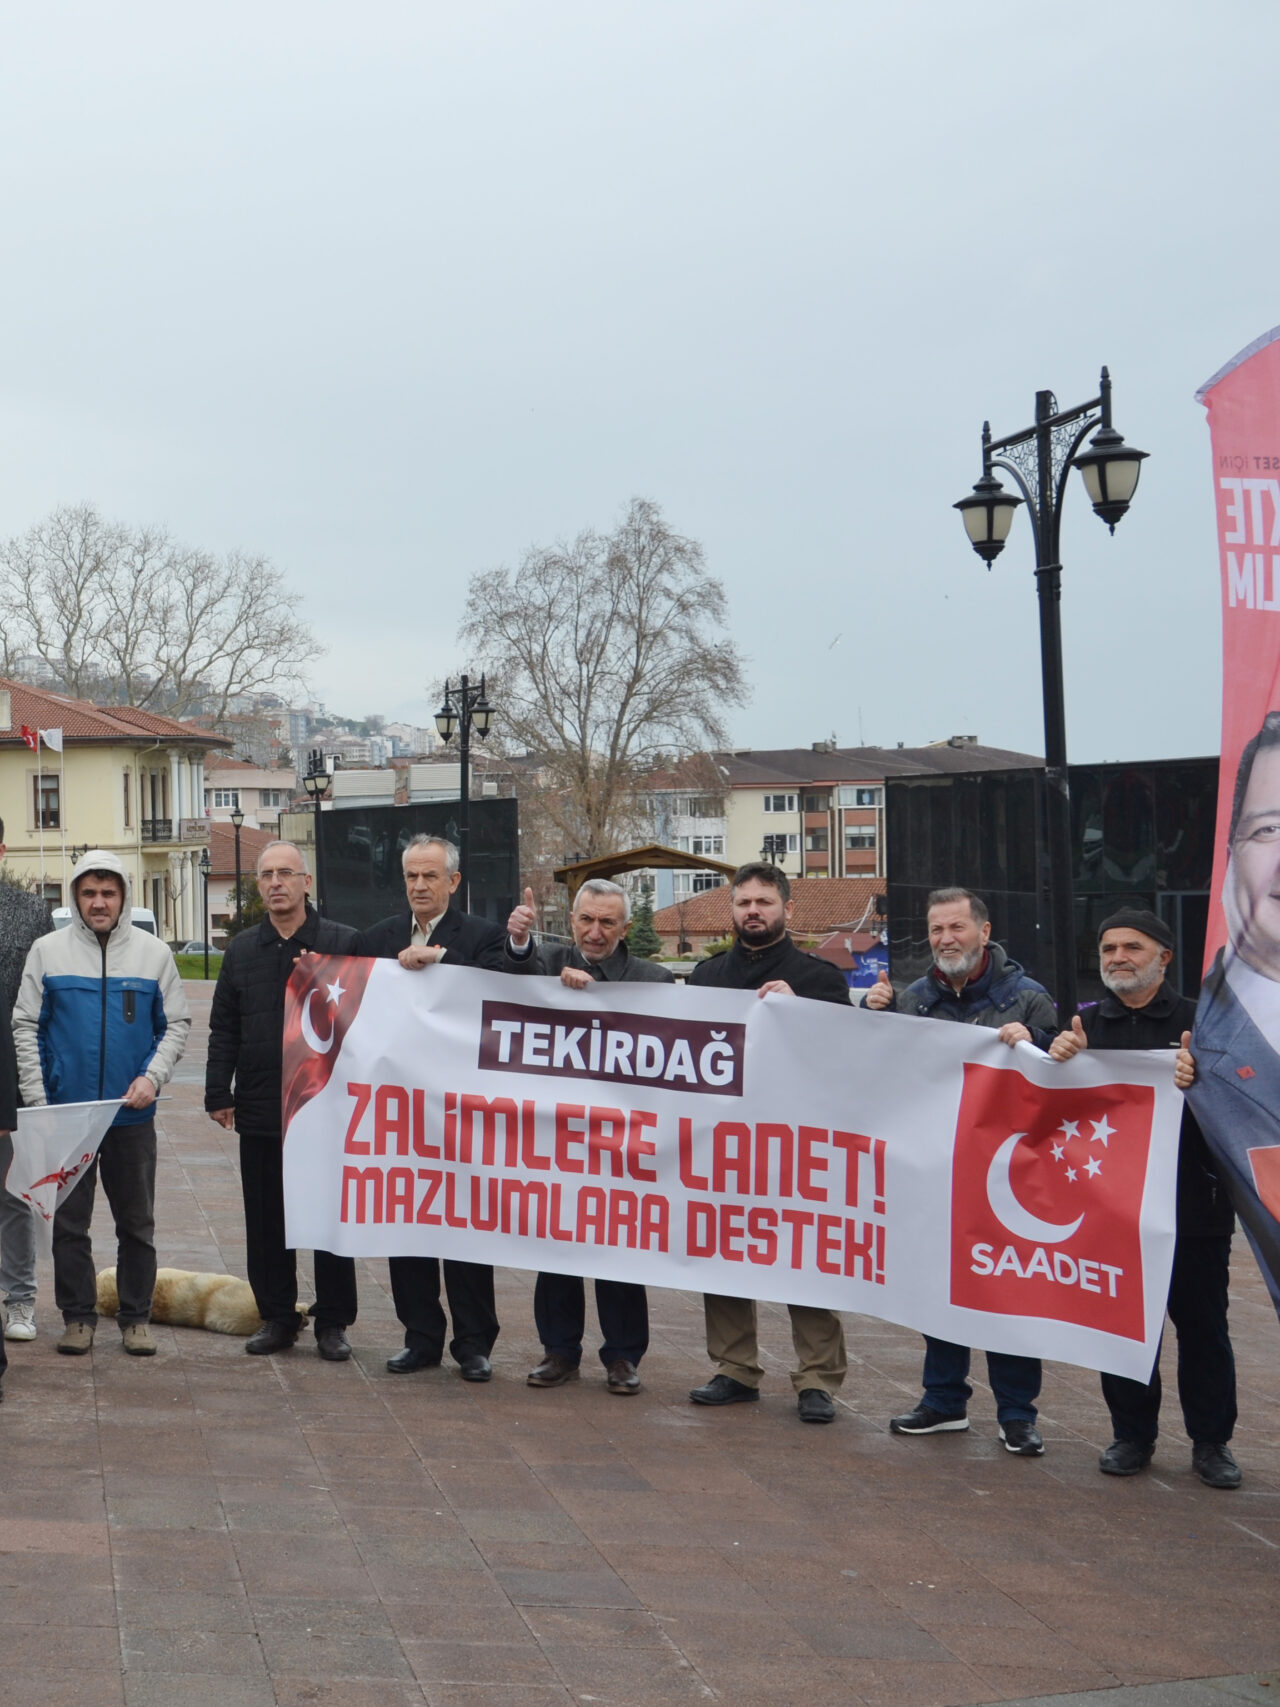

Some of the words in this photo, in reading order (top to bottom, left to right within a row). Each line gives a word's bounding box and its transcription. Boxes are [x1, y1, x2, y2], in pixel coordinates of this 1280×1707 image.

[491, 1019, 735, 1087] TEKİRDAĞ
[344, 1081, 658, 1183] ZALİMLERE
[679, 1116, 887, 1215] LANET!
[340, 1165, 670, 1254] MAZLUMLARA
[686, 1200, 886, 1286] DESTEK!
[970, 1242, 1123, 1298] SAADET
